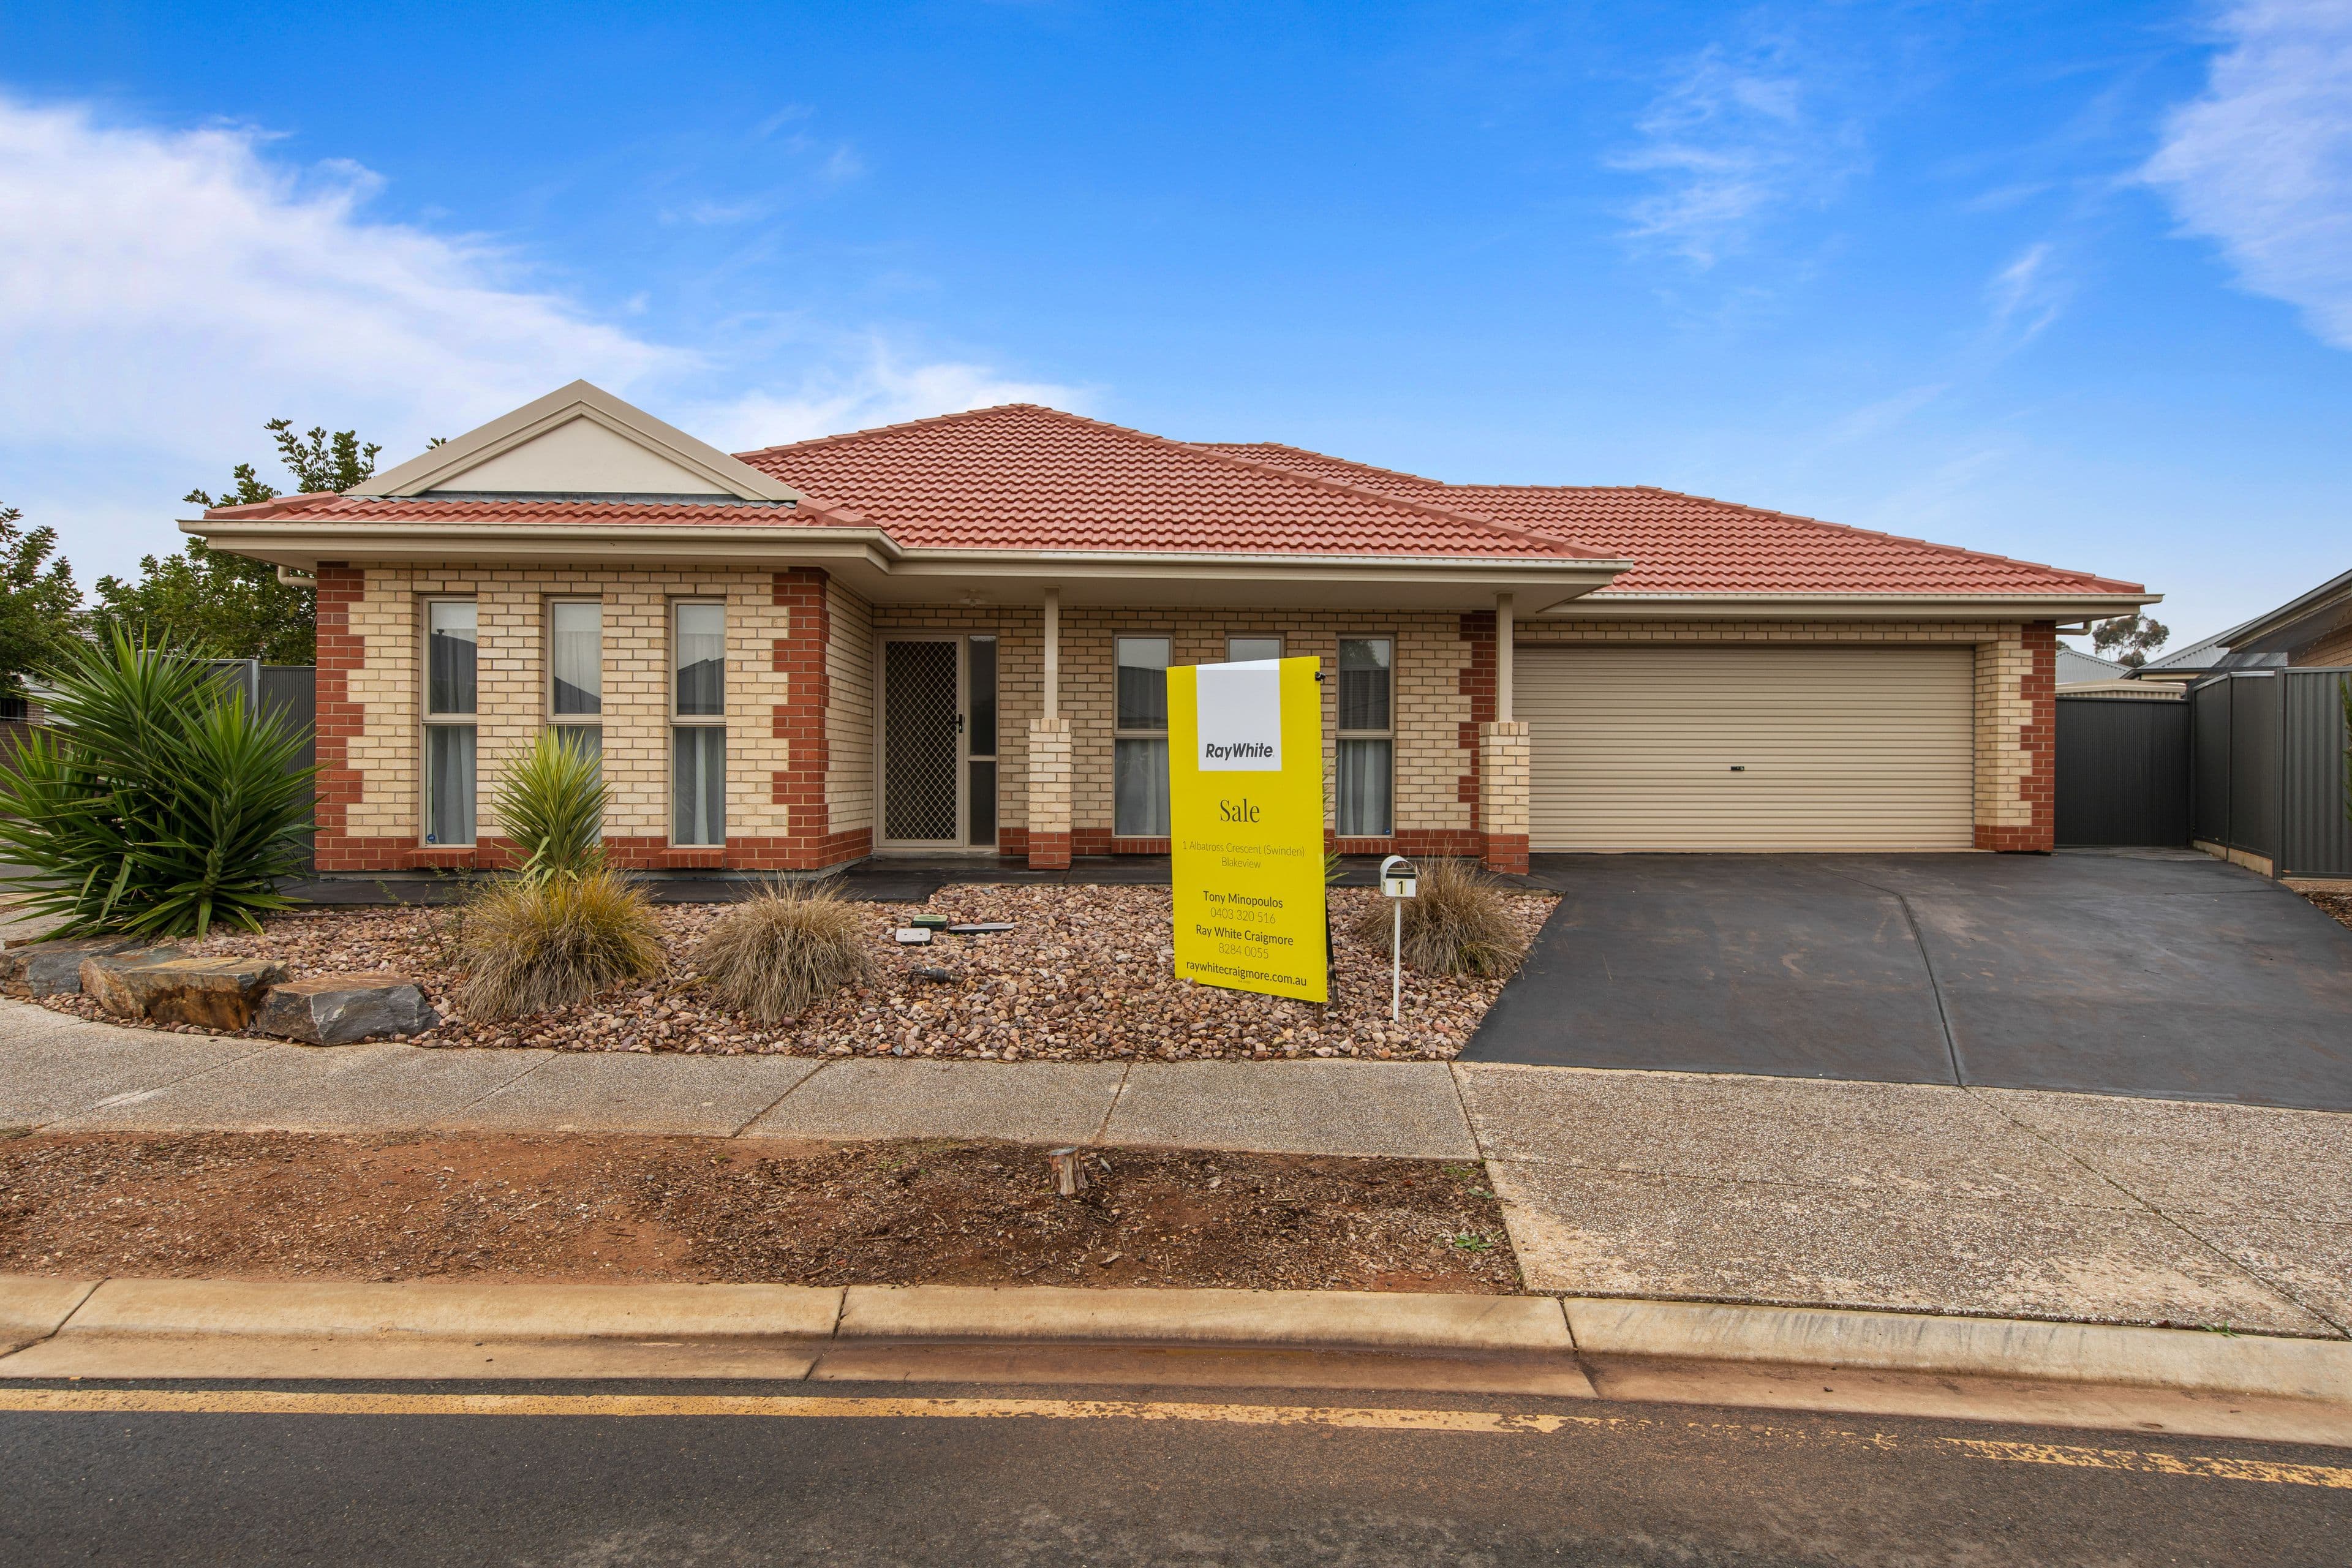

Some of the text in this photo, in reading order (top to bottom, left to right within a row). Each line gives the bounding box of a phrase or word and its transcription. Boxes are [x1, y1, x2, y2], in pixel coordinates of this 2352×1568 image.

[1220, 798, 1260, 823] Sale
[1183, 840, 1305, 858] 1 Albatross Crescent (Swinden)
[1222, 858, 1261, 869] Blakeview
[1398, 881, 1403, 894] 1
[1204, 891, 1283, 908] Tony Minopoulos
[1210, 908, 1276, 924] 0403 320 516
[1196, 924, 1294, 945] Ray White Craigmore
[1219, 943, 1269, 959] 8284 0055
[1186, 961, 1306, 986] raywhitecraigmore.com.au
